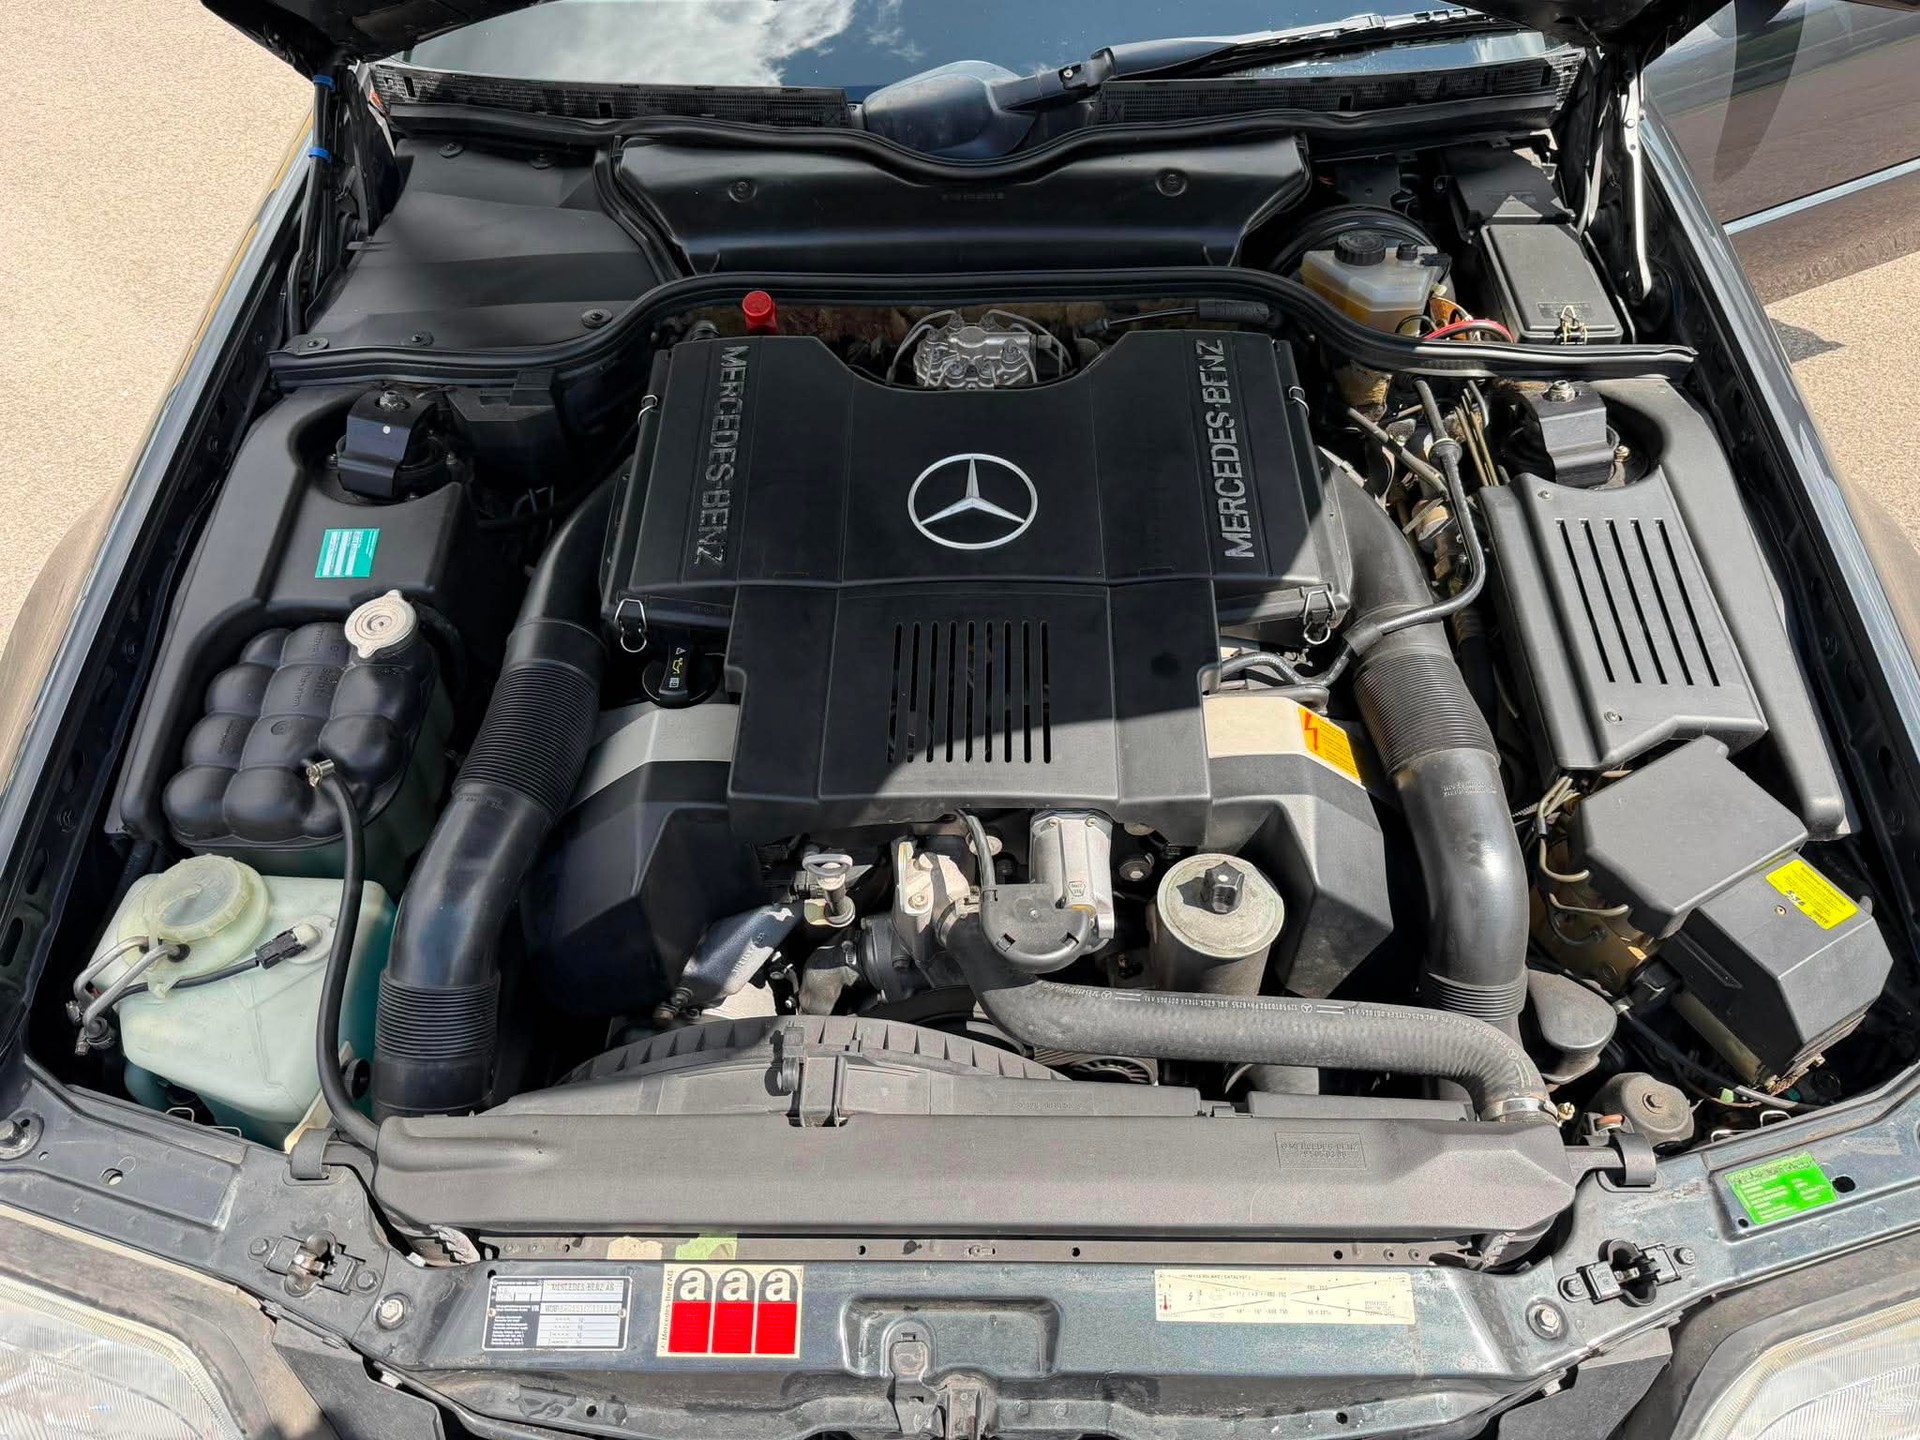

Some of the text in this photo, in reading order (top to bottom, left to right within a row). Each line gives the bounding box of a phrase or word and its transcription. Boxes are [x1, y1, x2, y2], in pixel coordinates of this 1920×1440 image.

[694, 345, 749, 566] MERCEDES-BENZ
[1196, 339, 1255, 558] MERCEDES-BENZ
[680, 1270, 791, 1302] a a a
